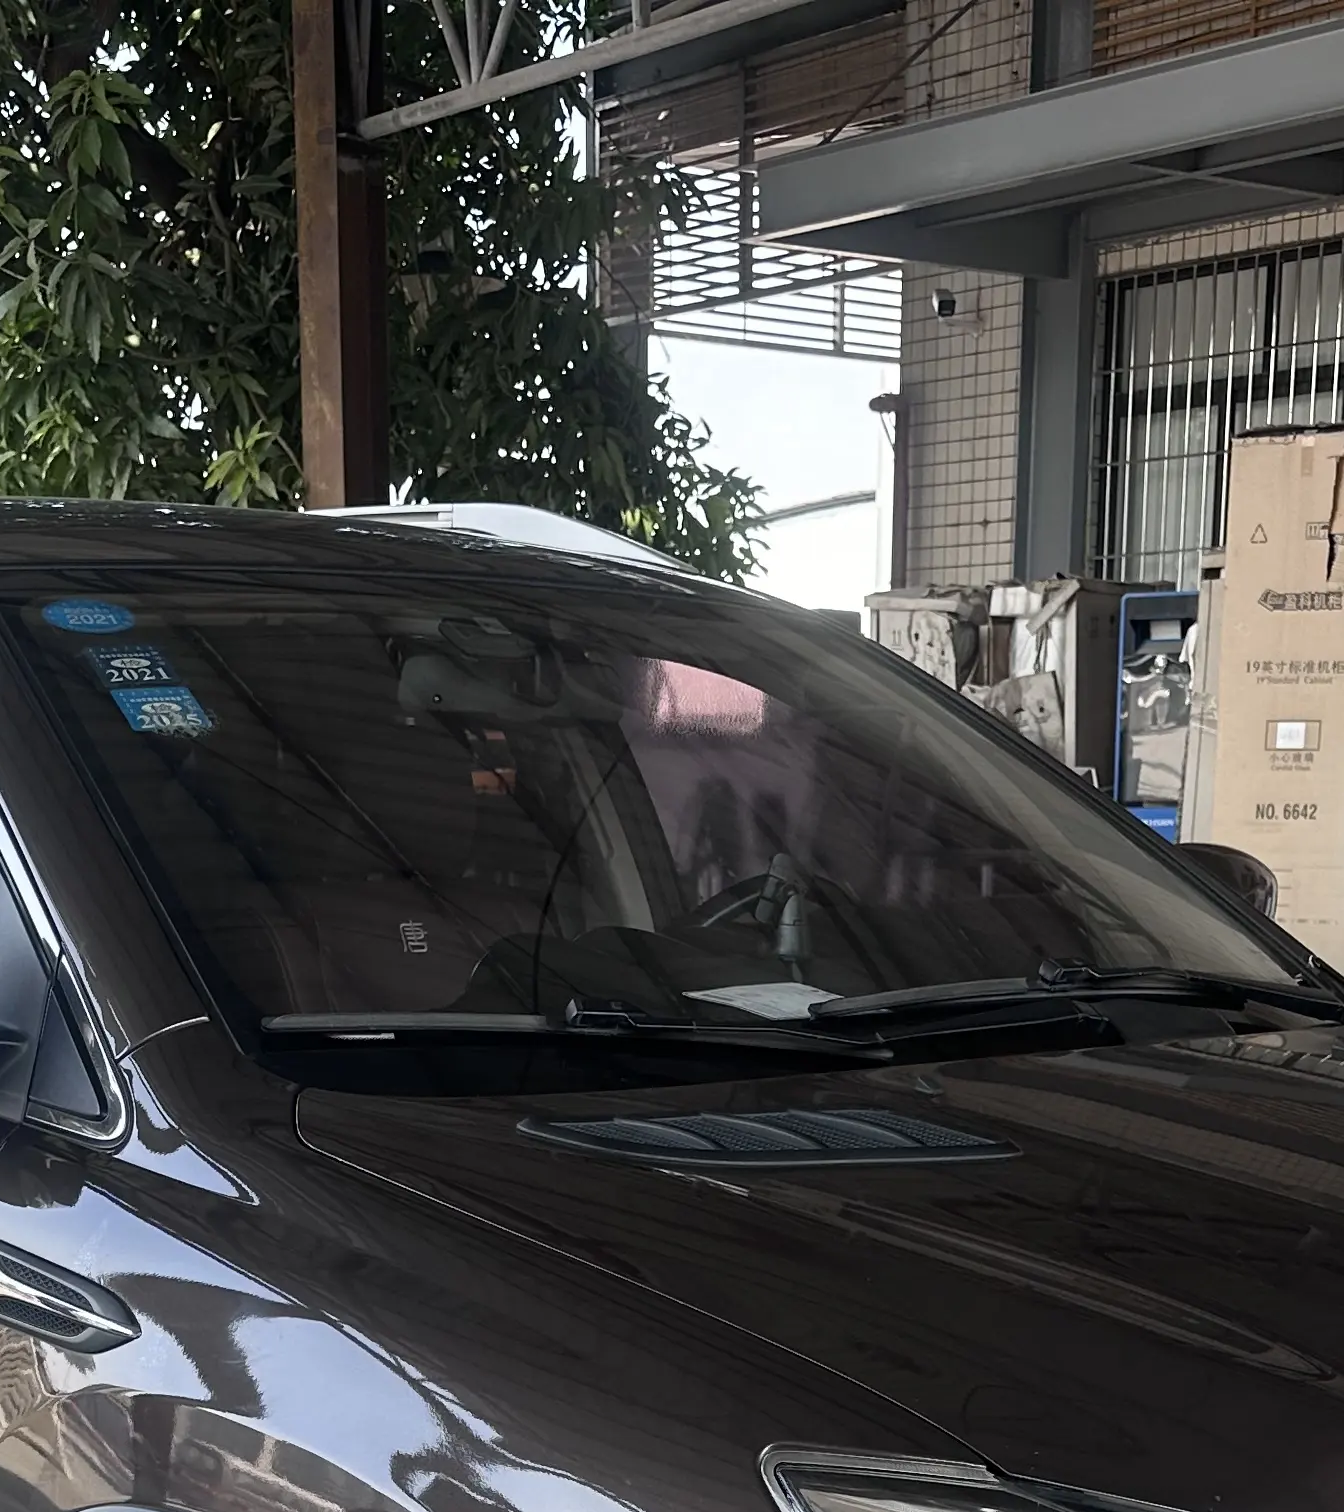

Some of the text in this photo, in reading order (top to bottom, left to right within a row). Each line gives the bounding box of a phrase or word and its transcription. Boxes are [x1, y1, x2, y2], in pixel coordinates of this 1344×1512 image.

[67, 614, 118, 625] 2021
[106, 667, 172, 683] 2021
[1246, 660, 1344, 674] 19英寸标准机柜
[1256, 803, 1318, 820] NO. 6642
[399, 919, 428, 953] 唐
